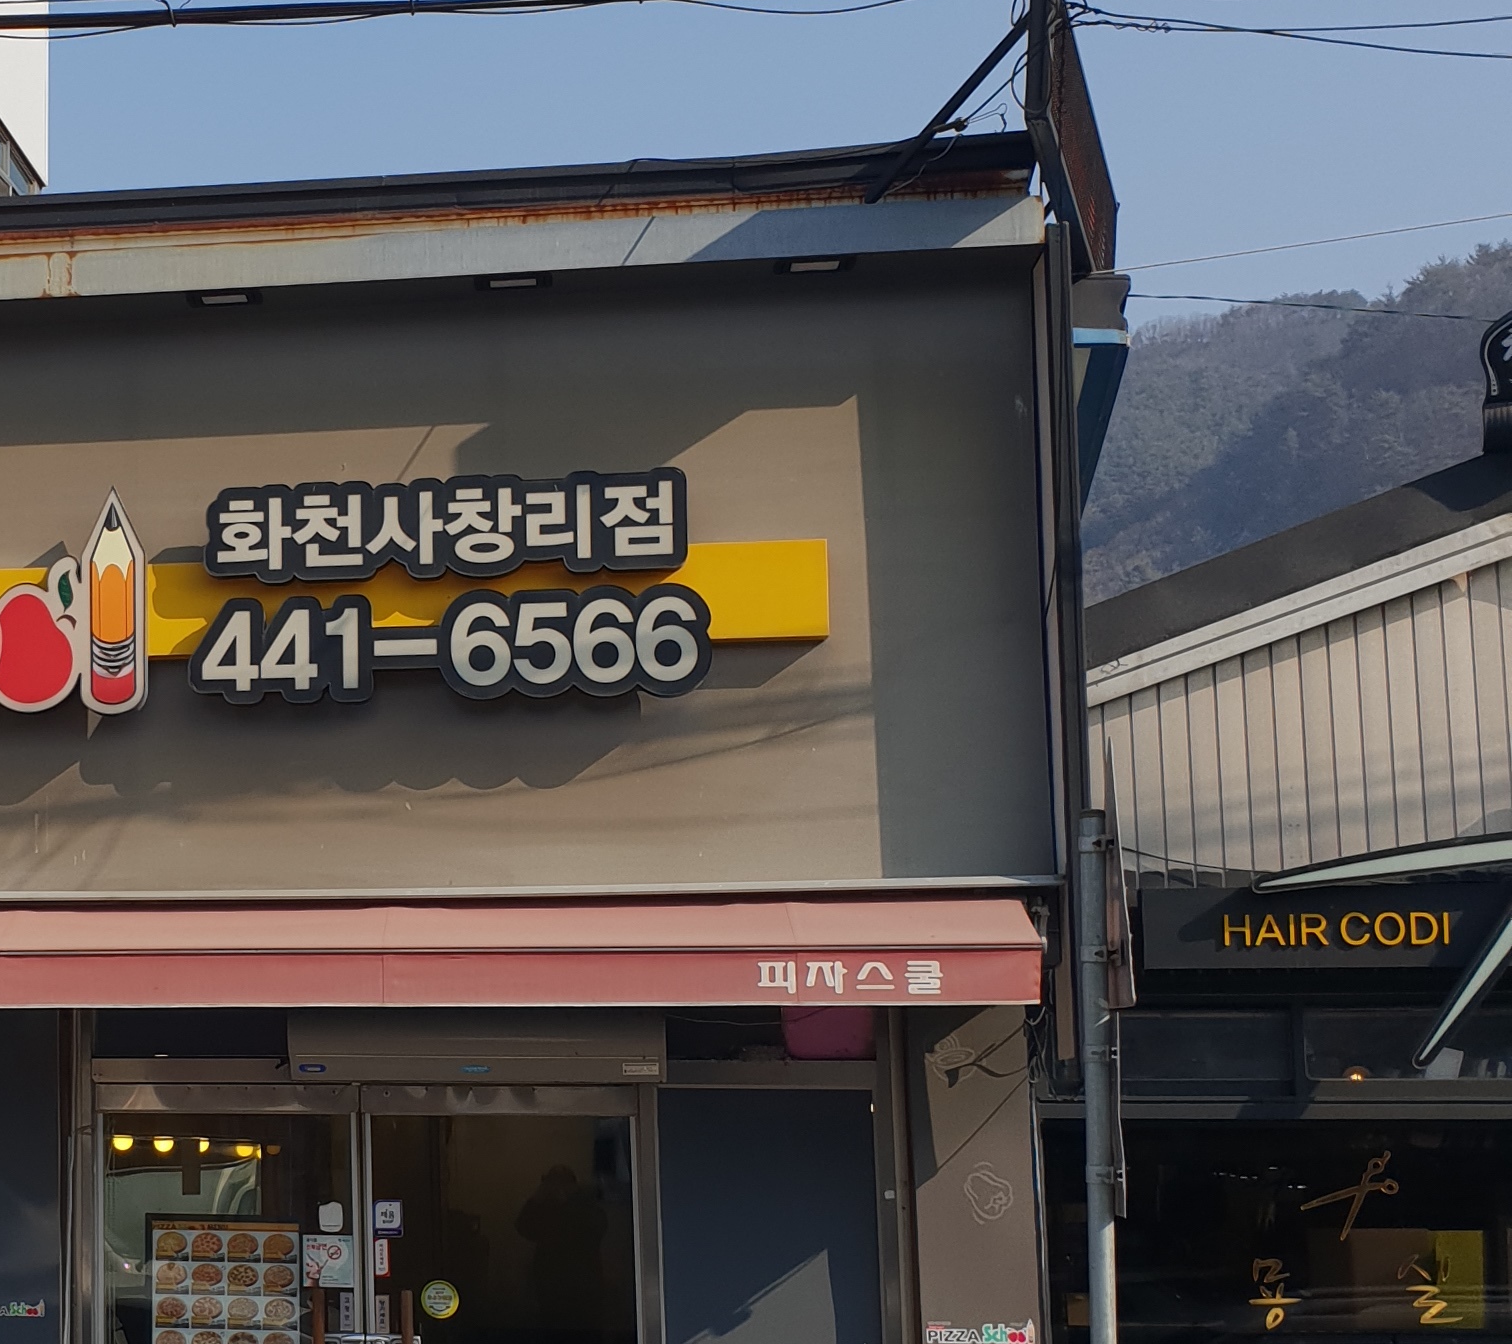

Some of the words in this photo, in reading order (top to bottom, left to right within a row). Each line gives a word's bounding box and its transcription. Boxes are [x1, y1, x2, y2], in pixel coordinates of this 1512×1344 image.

[211, 478, 678, 574] 화천사창리점
[200, 596, 699, 692] 441-6566
[1222, 913, 1326, 947] HAIR
[1339, 910, 1451, 945] CODI
[757, 960, 943, 995] 피자스쿨
[926, 1329, 982, 1344] PIZZA
